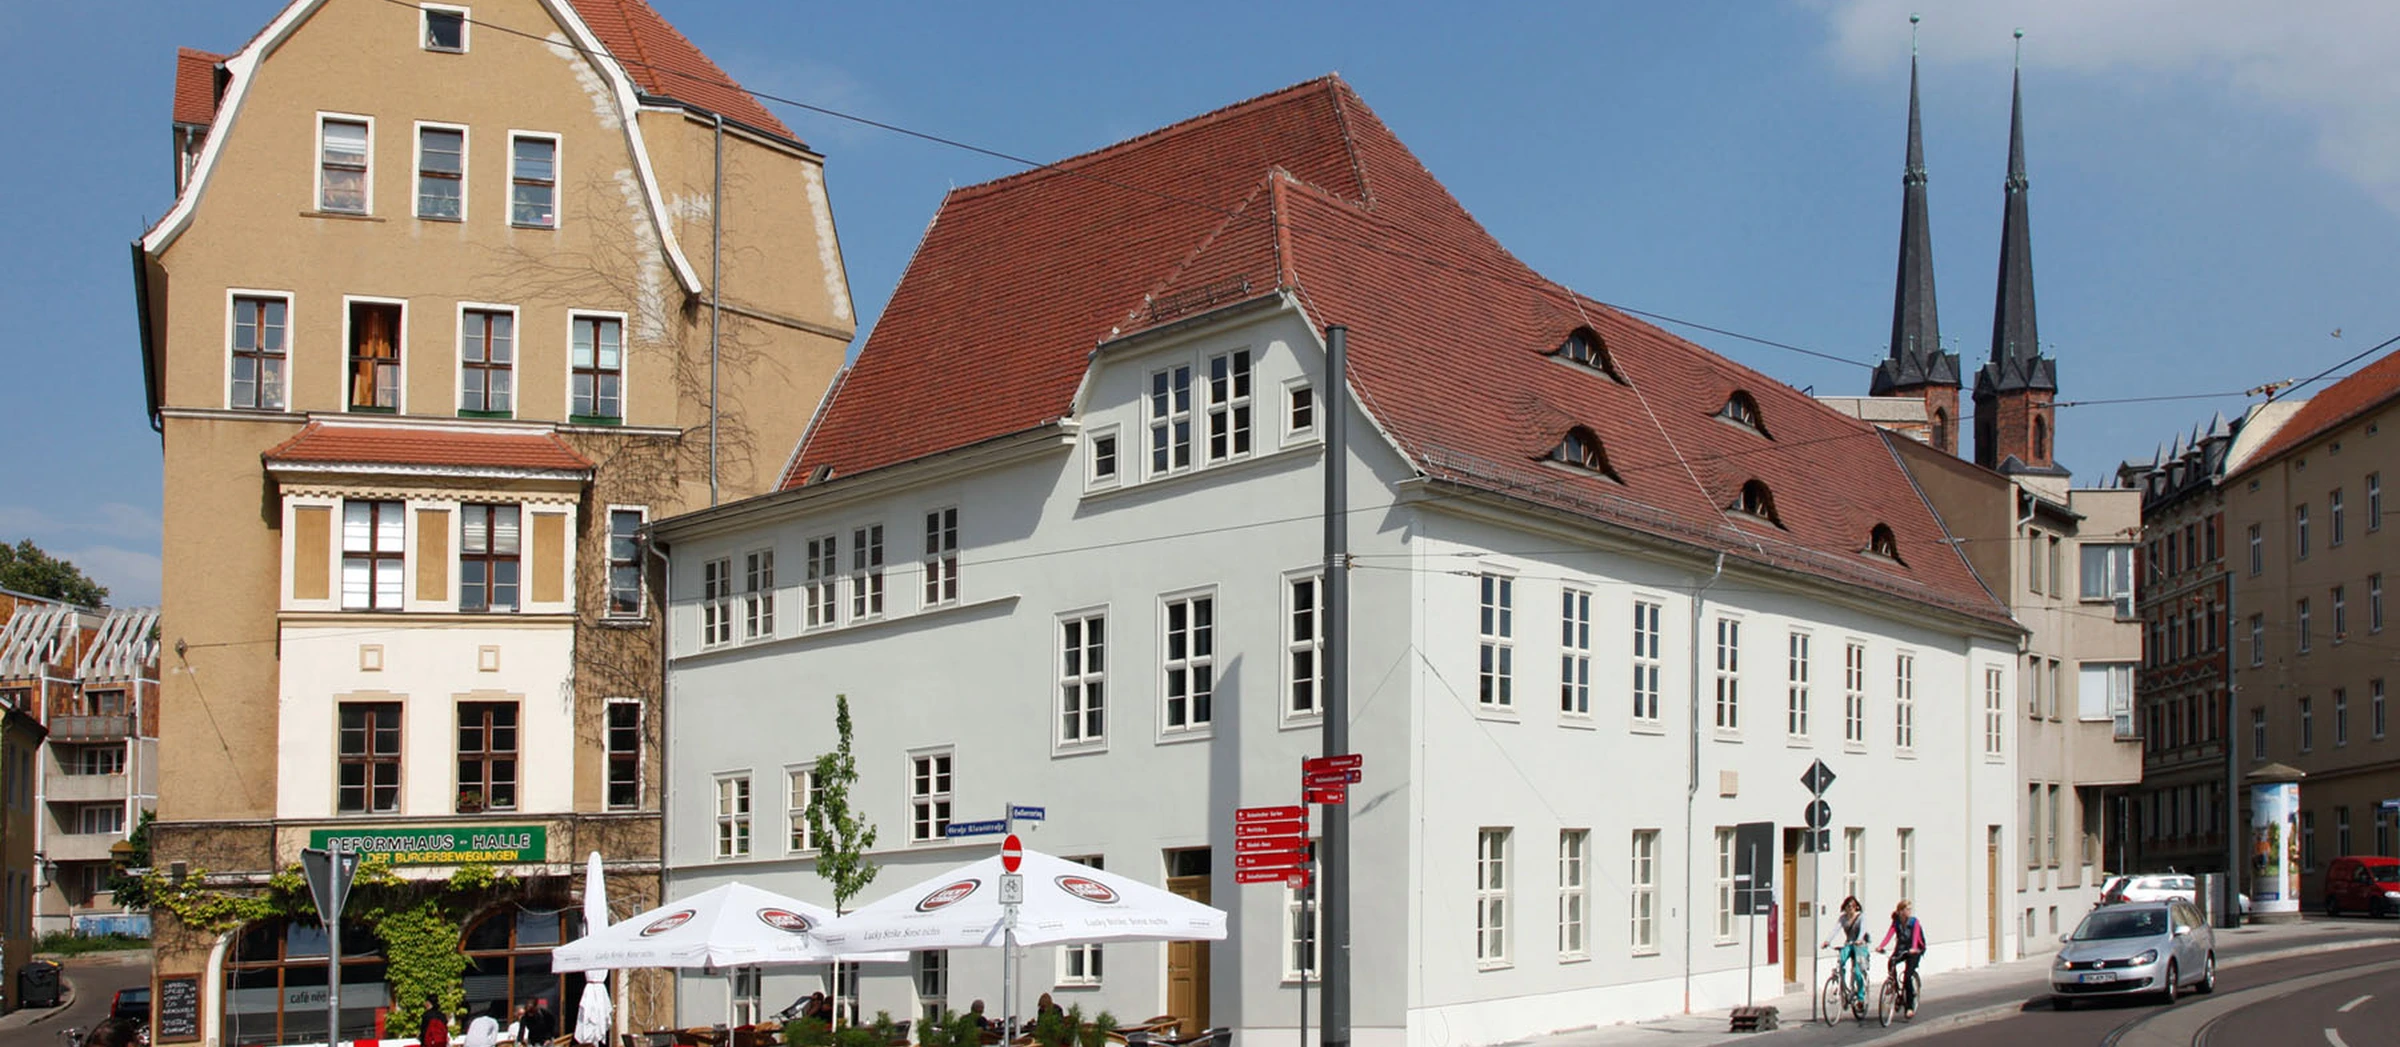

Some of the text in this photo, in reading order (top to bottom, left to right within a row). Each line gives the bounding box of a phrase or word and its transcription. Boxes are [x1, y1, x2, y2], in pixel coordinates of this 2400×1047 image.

[472, 833, 531, 849] HALLE
[367, 852, 391, 863] DER
[394, 849, 519, 863] BÜRGERBEWEGUNGEN
[290, 991, 309, 1004] café
